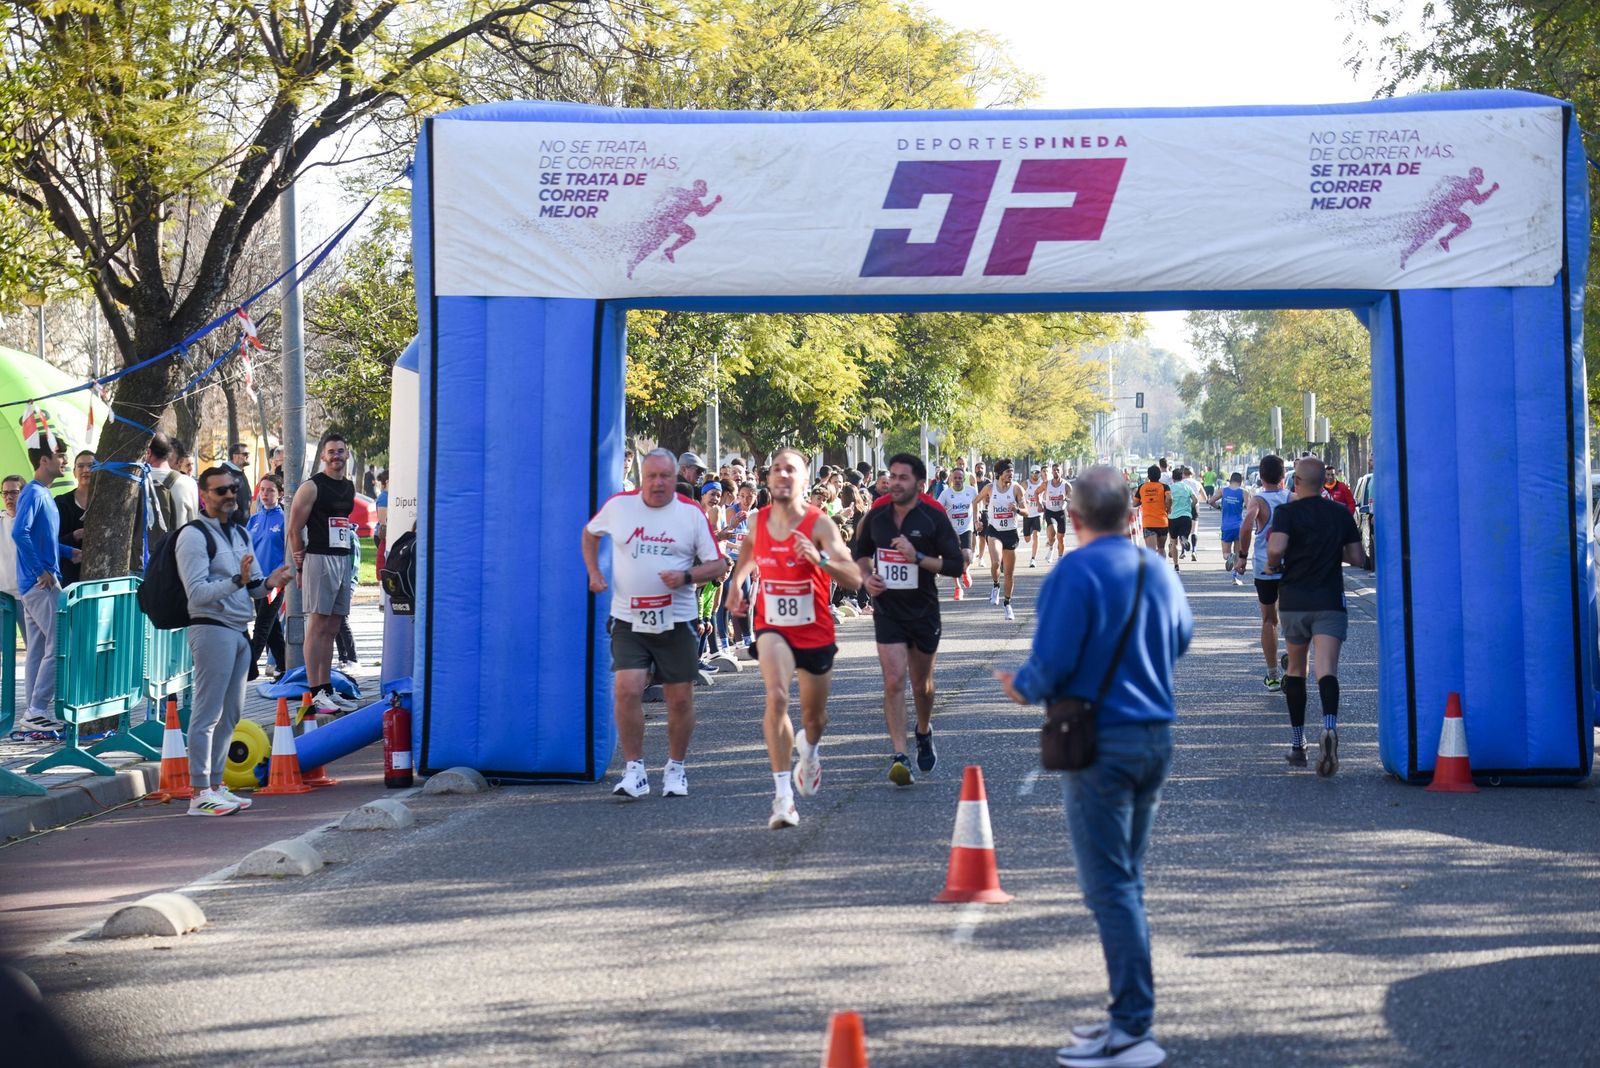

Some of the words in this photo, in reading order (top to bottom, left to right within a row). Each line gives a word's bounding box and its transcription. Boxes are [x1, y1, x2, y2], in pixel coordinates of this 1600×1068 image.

[1309, 131, 1336, 145] NO
[1340, 130, 1363, 144] SE
[1367, 129, 1421, 143] TRATA
[538, 140, 566, 153] NO
[569, 140, 592, 153] SE
[597, 140, 648, 153] TRATA
[1309, 147, 1333, 161] DE
[1337, 145, 1410, 160] CORRER
[538, 156, 563, 169] DE
[566, 156, 637, 170] CORRER
[640, 153, 681, 171] MÁS,
[1310, 164, 1333, 177] SE
[1337, 162, 1392, 177] TRATA
[1396, 162, 1422, 175] DE
[539, 172, 562, 186] SE
[566, 172, 619, 186] TRATA
[623, 172, 648, 186] DE
[1310, 180, 1382, 194] CORRER
[538, 188, 609, 202] CORRER
[1310, 196, 1372, 210] MEJOR
[538, 205, 599, 218] MEJOR
[999, 519, 1009, 527] 48
[631, 542, 674, 559] JEREZ
[884, 565, 908, 582] 186
[777, 598, 798, 617] 88
[640, 609, 665, 626] 231
